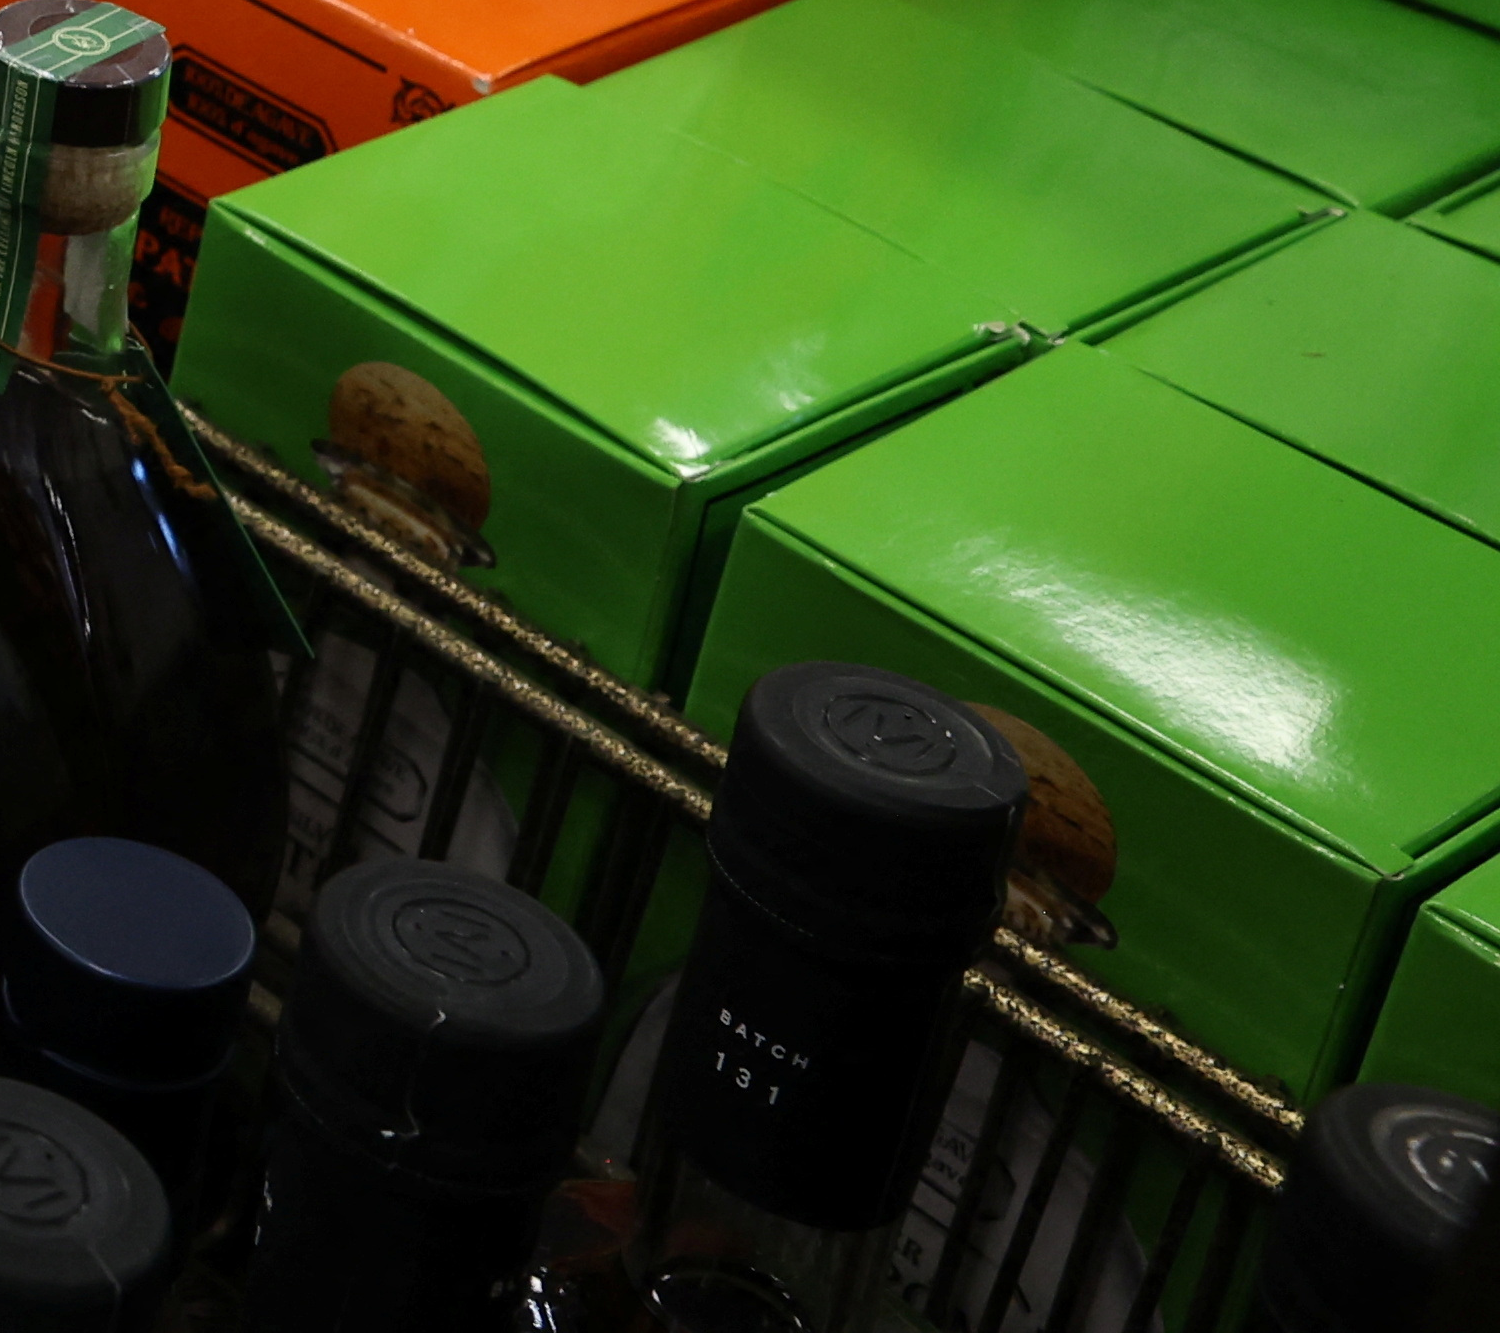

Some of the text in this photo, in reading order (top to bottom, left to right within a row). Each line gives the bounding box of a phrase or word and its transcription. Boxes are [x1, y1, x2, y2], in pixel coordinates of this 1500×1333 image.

[0, 146, 18, 194] LINCOLN
[719, 1007, 809, 1070] BATCH
[716, 1051, 779, 1105] 131
